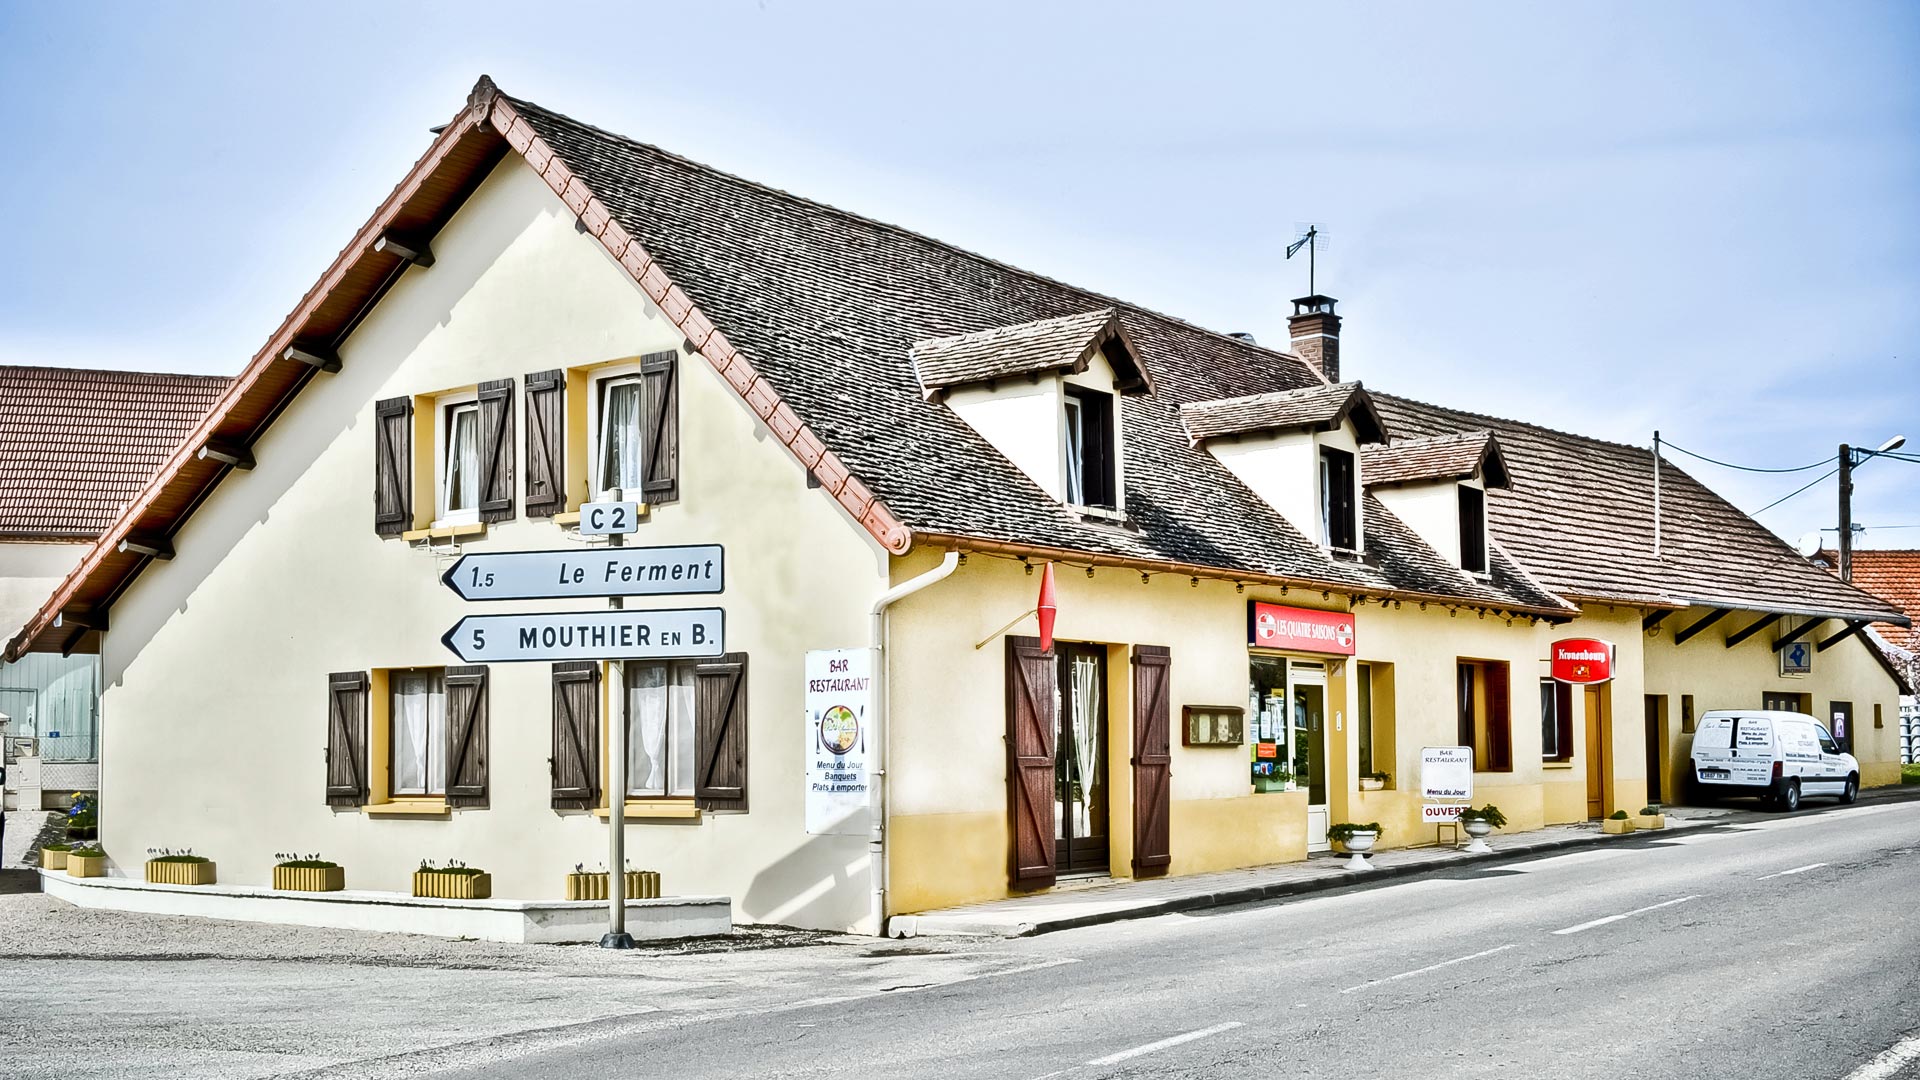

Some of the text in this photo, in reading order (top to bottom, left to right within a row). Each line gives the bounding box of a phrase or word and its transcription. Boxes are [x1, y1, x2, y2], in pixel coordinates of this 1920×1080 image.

[590, 507, 626, 529] C 2
[471, 560, 713, 588] 1.5 Le Ferment
[473, 623, 714, 651] 5 MOUTHIER EN B.
[1277, 620, 1287, 635] LES
[1287, 621, 1311, 639] QUATRE
[1311, 623, 1335, 640] SAISONS
[1558, 648, 1606, 663] Kronenbourg
[829, 659, 849, 673] BAR
[809, 677, 870, 693] RESTAURANT
[816, 761, 863, 769] Menu du Jour
[824, 772, 857, 782] Banquets
[812, 783, 829, 791] Plats
[836, 784, 867, 793] emporter
